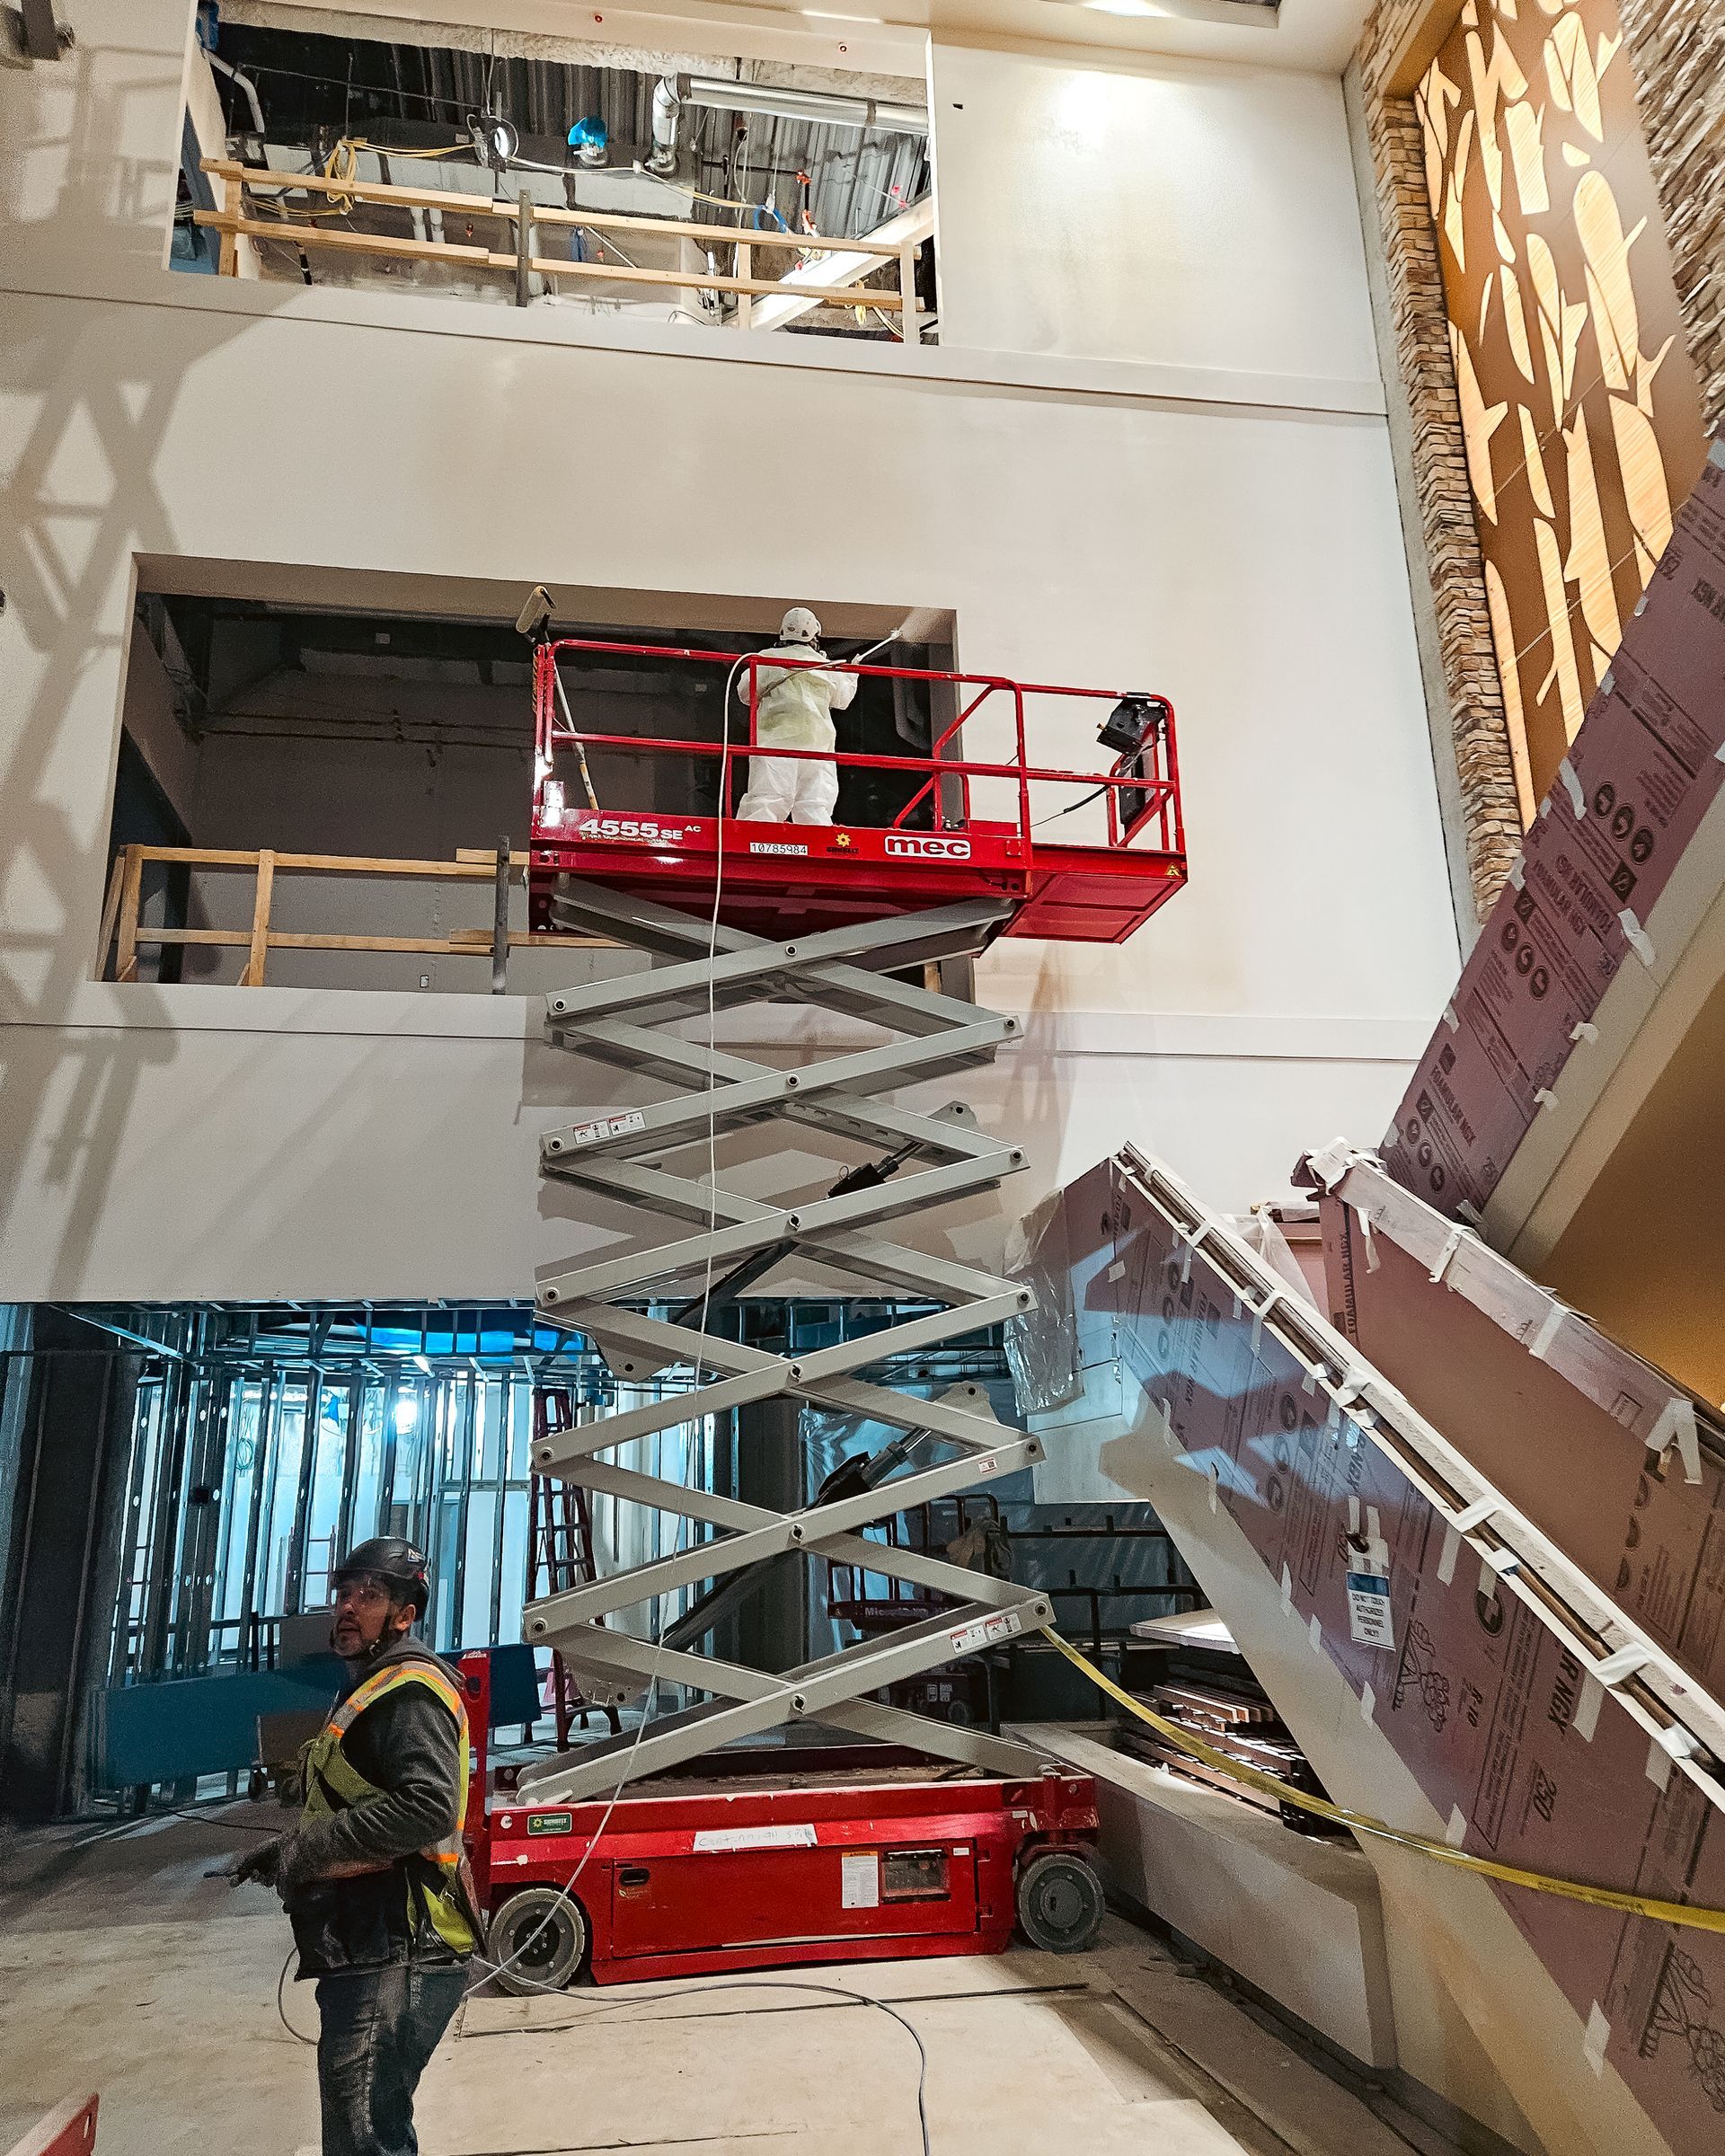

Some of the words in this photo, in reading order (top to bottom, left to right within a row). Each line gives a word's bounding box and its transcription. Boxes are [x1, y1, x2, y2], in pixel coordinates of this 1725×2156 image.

[751, 843, 807, 855] 10785984
[887, 837, 969, 857] mec
[1532, 1765, 1558, 1823] 250
